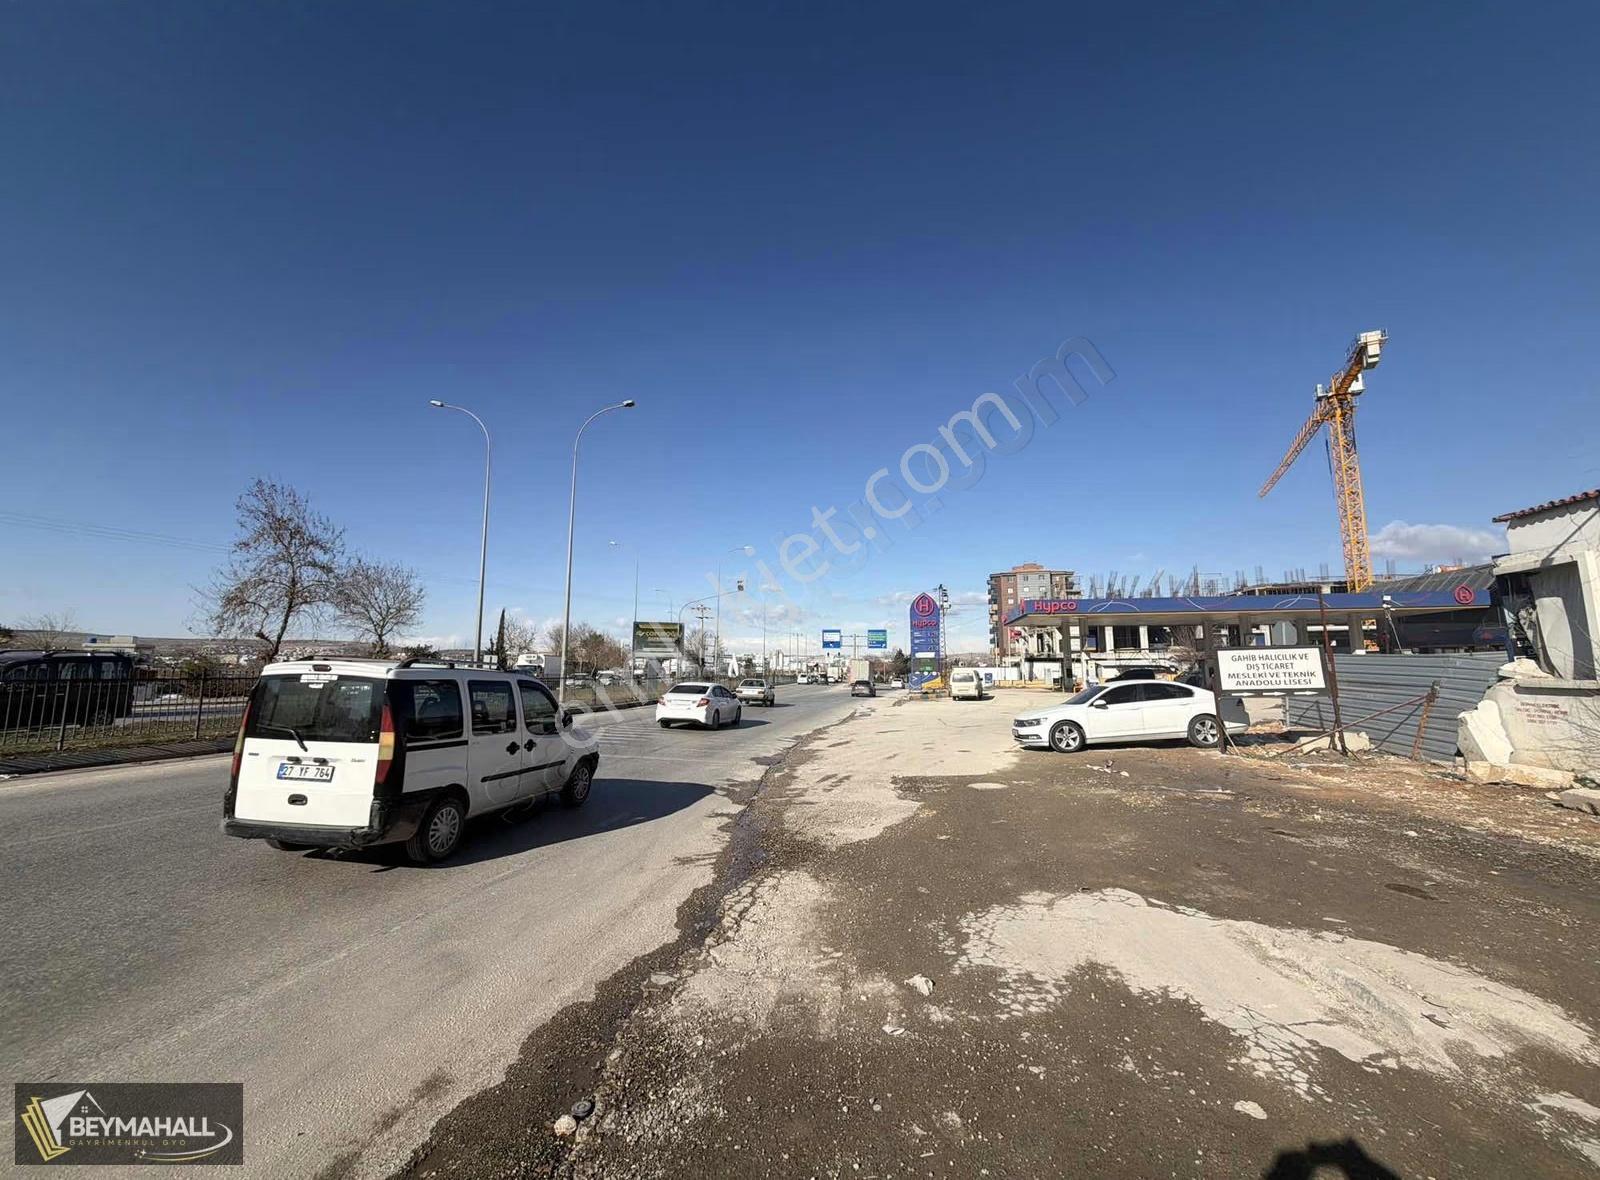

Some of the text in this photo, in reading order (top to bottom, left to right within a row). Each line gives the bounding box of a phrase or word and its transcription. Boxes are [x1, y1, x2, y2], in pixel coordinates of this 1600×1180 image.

[1034, 601, 1077, 613] Hypco
[282, 766, 330, 778] 27 YF 764
